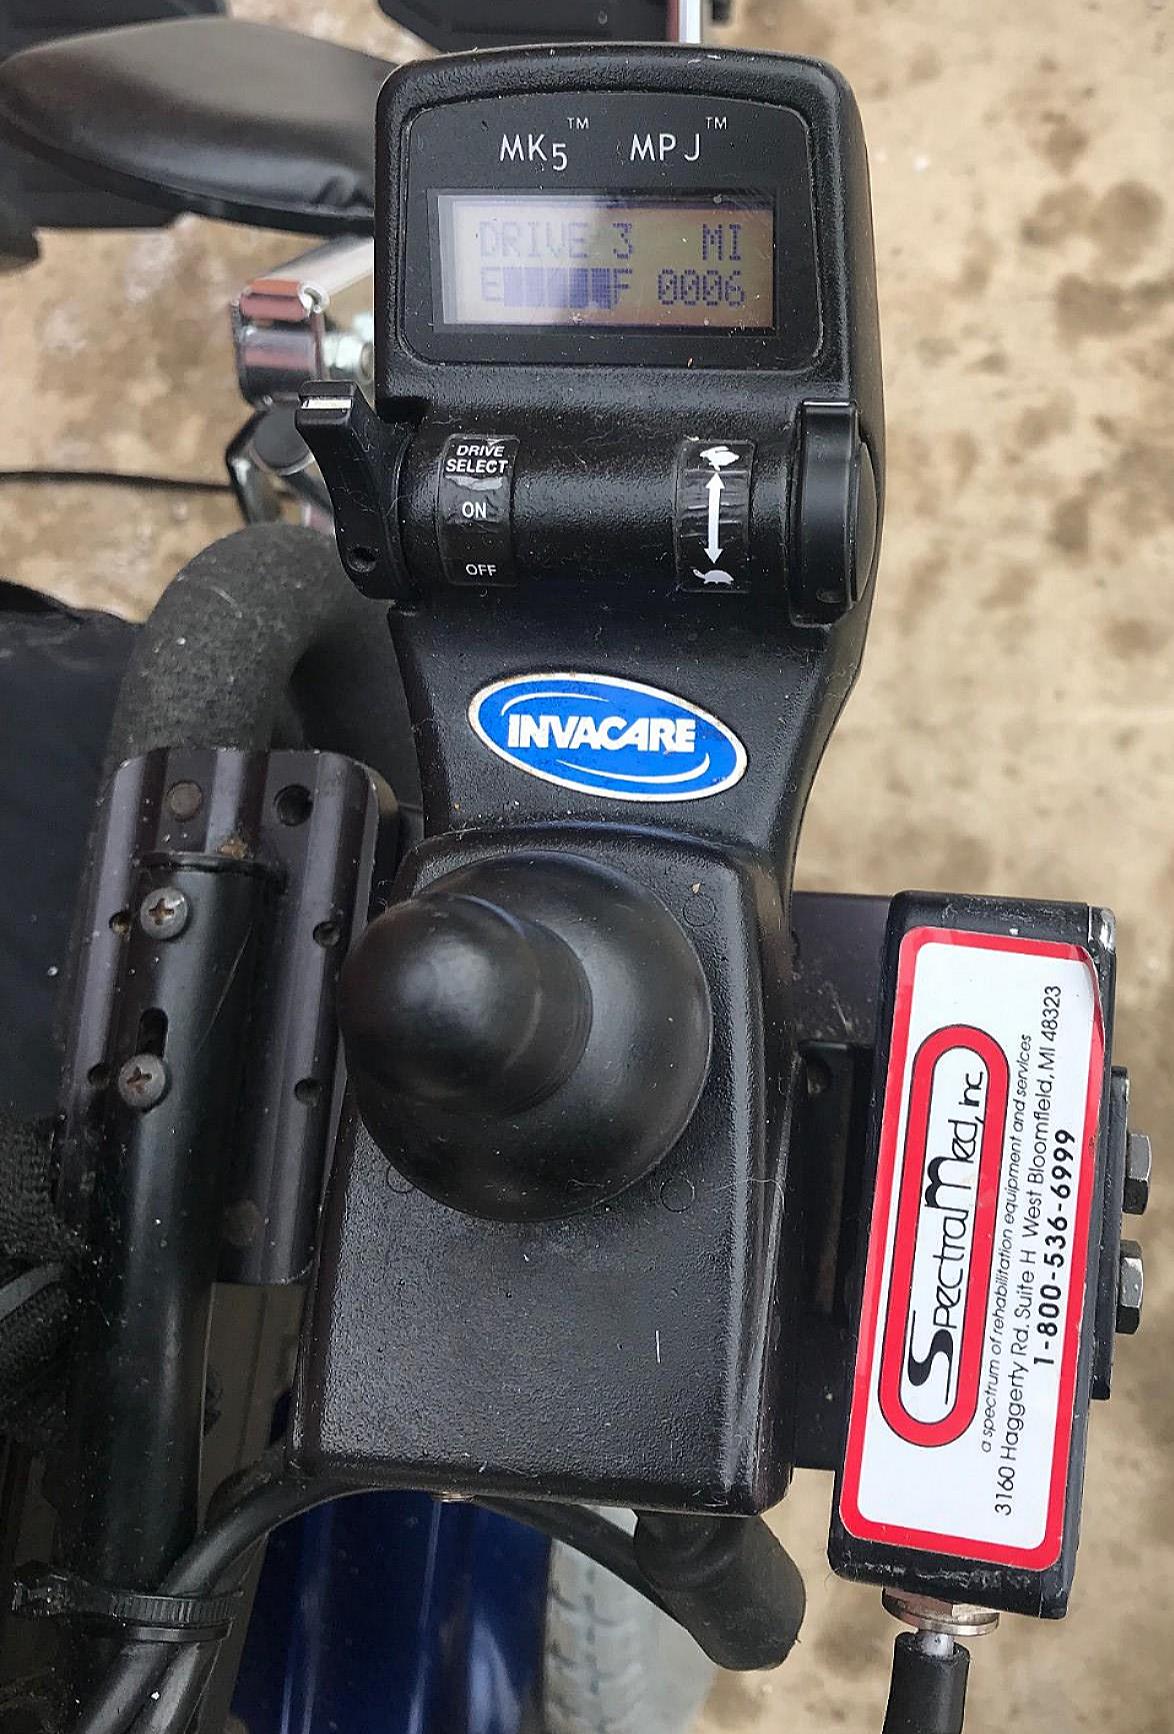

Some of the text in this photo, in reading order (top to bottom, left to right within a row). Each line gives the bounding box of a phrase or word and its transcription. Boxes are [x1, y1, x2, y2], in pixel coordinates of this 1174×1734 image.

[499, 133, 569, 171] MK5
[480, 221, 742, 261] DRIVE 3 MI
[658, 269, 745, 306] 0006
[445, 458, 509, 474] SELECT
[456, 444, 505, 457] DRIVE
[461, 501, 487, 519] ON
[465, 563, 497, 576] OFF
[507, 714, 696, 753] INVACARE
[981, 1033, 1032, 1453] a spectrum of rehabilitation equipment and services
[994, 985, 1062, 1516] 3160 Haggerty Rd. Suite H West Bloomfield, MI 48323
[1033, 1129, 1076, 1365] 1-800-536-6999
